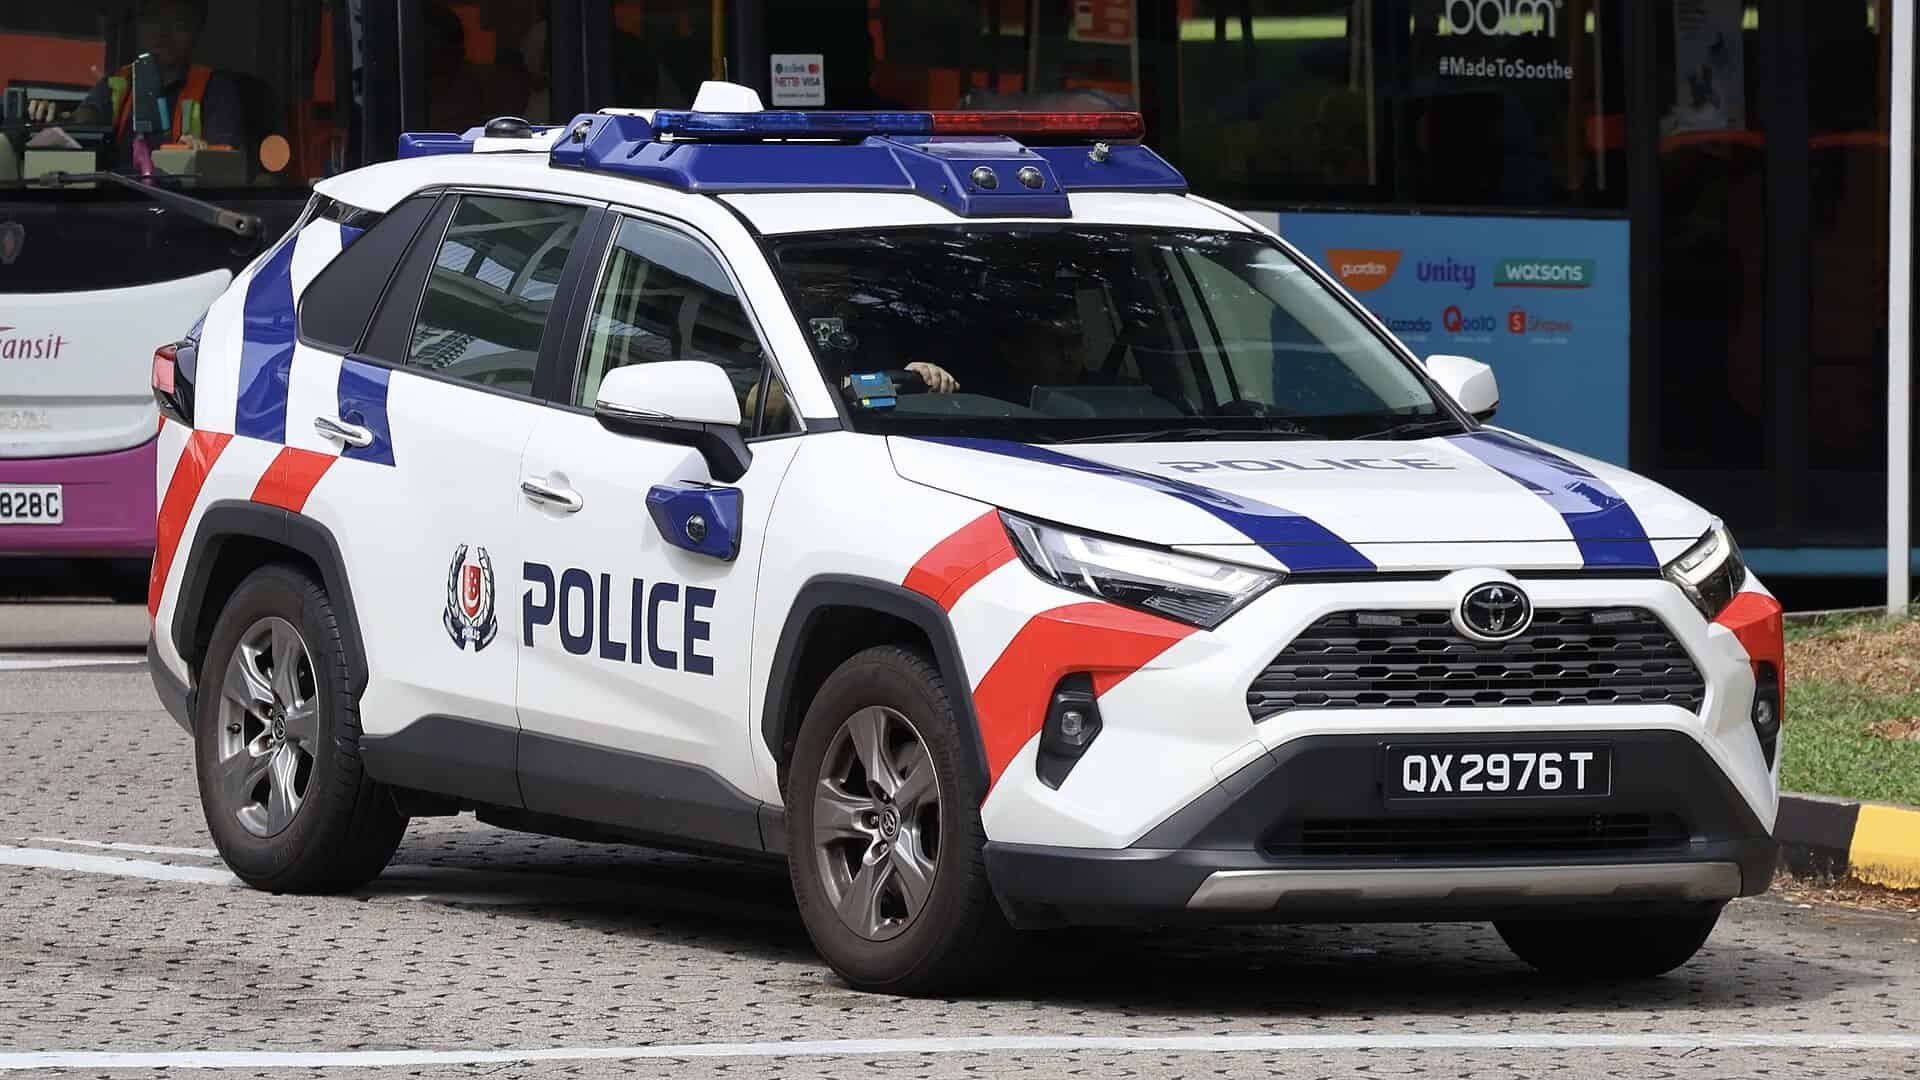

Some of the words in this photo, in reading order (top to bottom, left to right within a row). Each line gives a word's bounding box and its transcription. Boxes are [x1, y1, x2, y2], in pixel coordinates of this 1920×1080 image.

[1439, 57, 1573, 80] #MadeToSoothe
[1505, 263, 1584, 282] watsons
[1159, 458, 1457, 473] POLICE
[523, 561, 717, 677] POLICE
